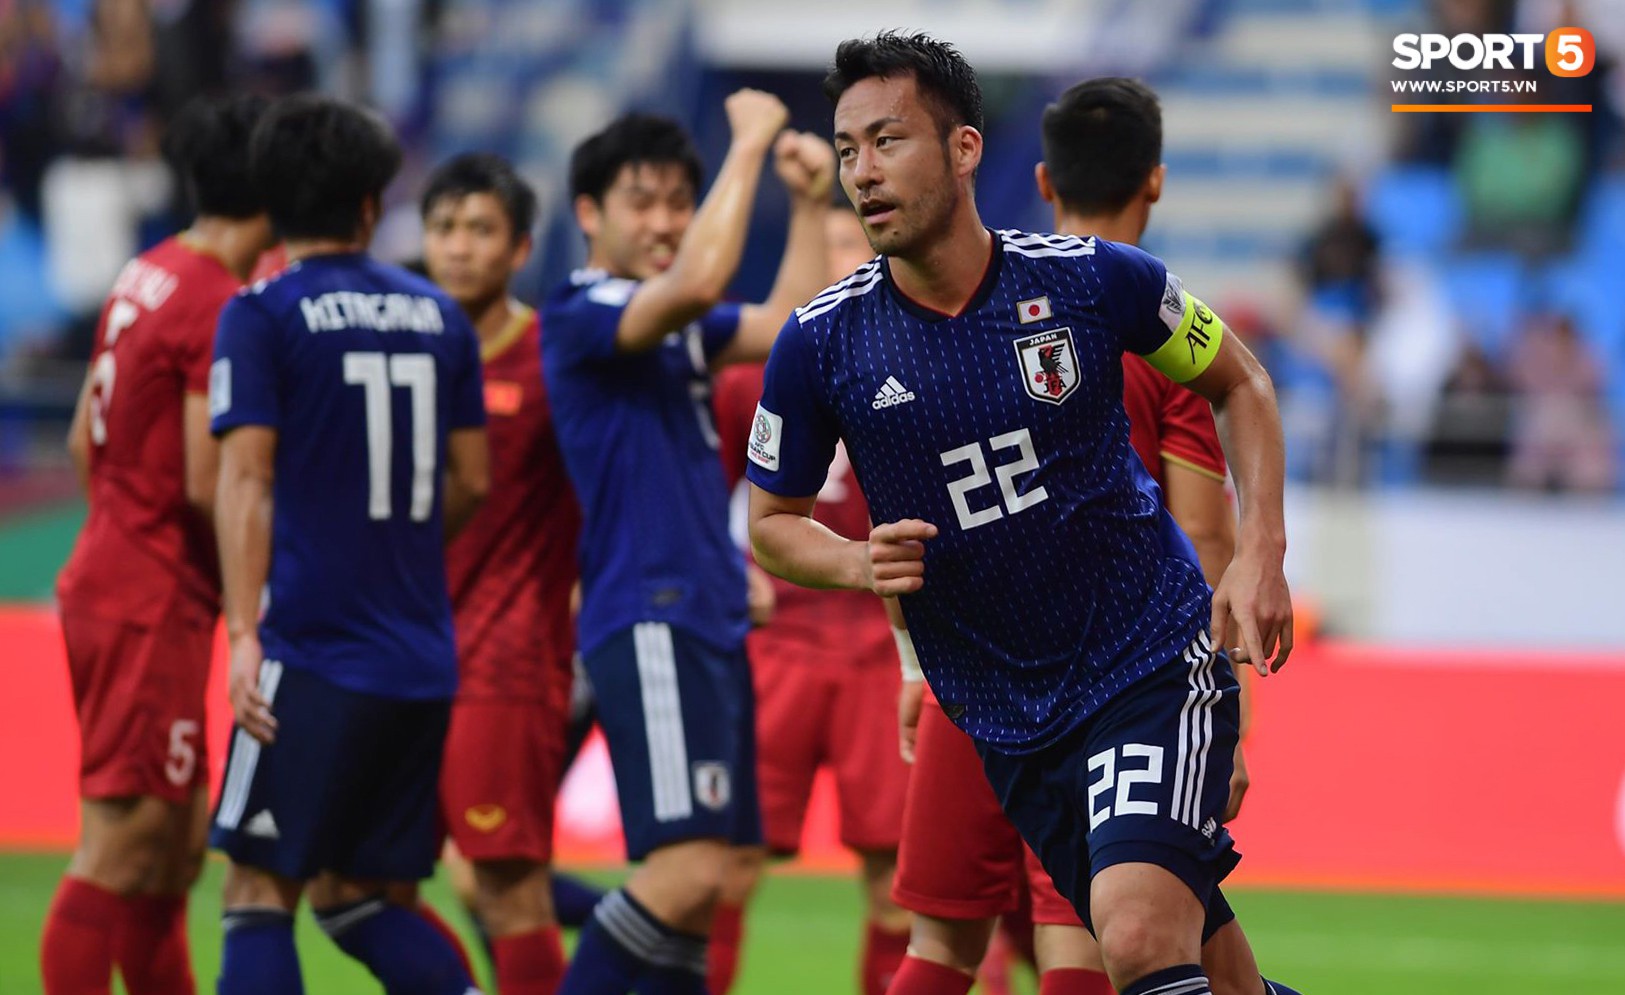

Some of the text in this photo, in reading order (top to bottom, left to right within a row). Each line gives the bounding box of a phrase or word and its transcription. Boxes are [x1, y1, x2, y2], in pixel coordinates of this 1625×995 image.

[300, 291, 445, 334] KITAGAWA
[1029, 333, 1058, 346] JAPAN
[872, 391, 916, 410] adidas
[343, 351, 437, 522] 11
[940, 427, 1049, 531] 22
[165, 719, 199, 786] 5
[1087, 743, 1164, 834] 22
